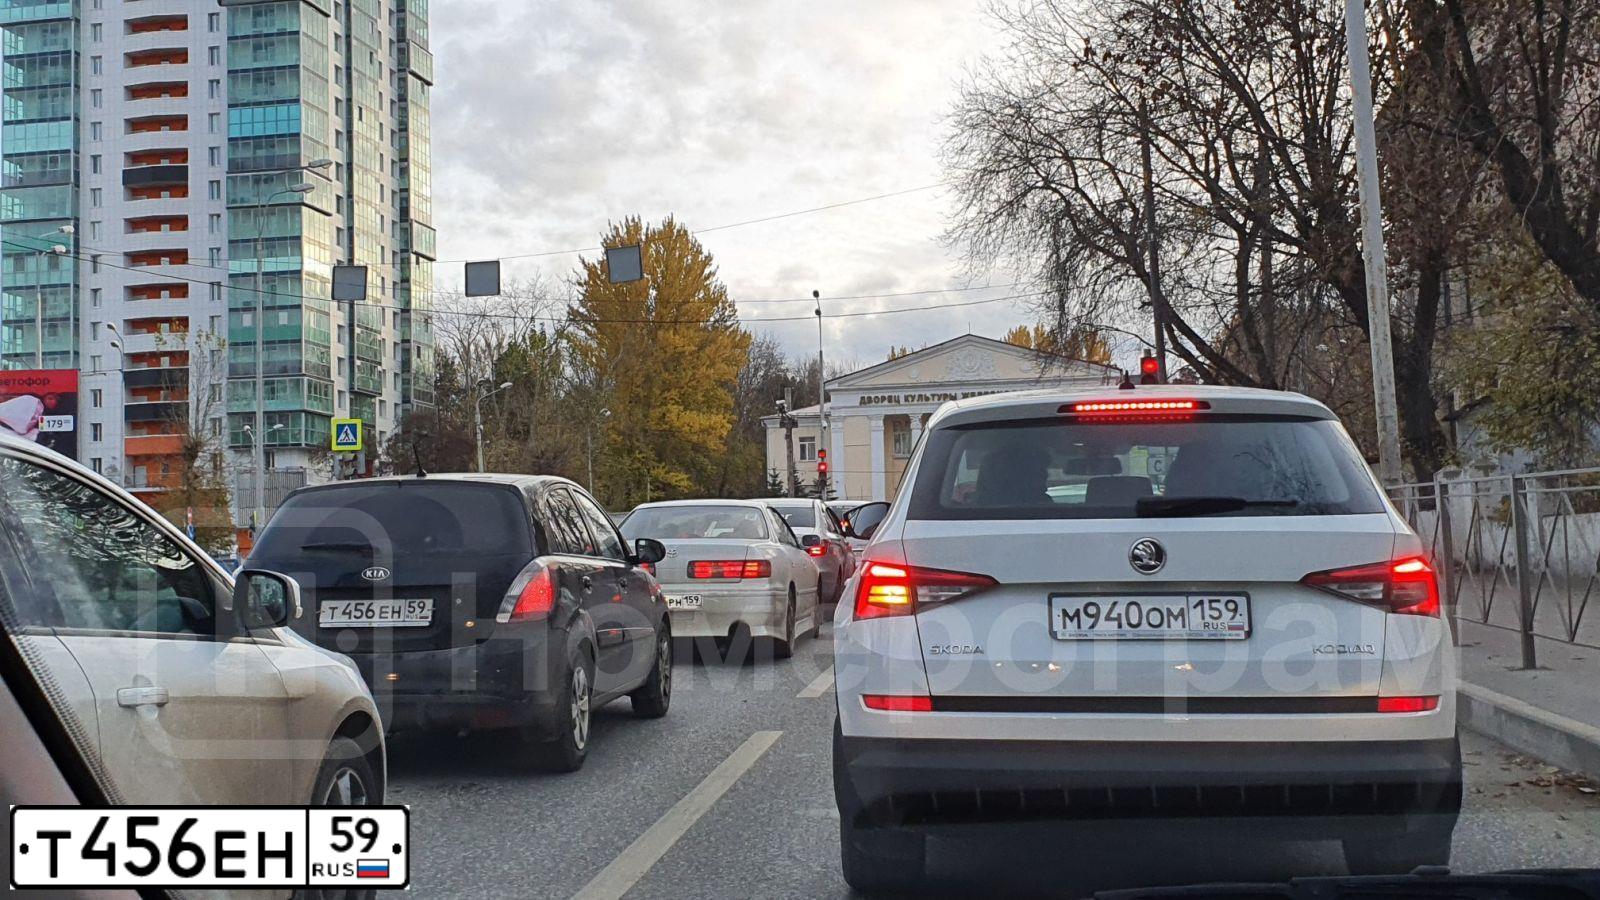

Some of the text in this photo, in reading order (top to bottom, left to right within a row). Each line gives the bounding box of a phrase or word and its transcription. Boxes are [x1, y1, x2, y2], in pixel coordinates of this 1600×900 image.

[859, 395, 900, 406] ДВОРЕЦ
[904, 393, 957, 402] КУЛЬТУРЫ
[46, 420, 63, 428] 179
[365, 570, 386, 578] KIA
[683, 595, 699, 604] 159
[407, 601, 426, 614] 59
[1061, 599, 1239, 630] М940ОМ 159
[1203, 621, 1226, 630] RUS
[1312, 644, 1376, 655] KODIAQ
